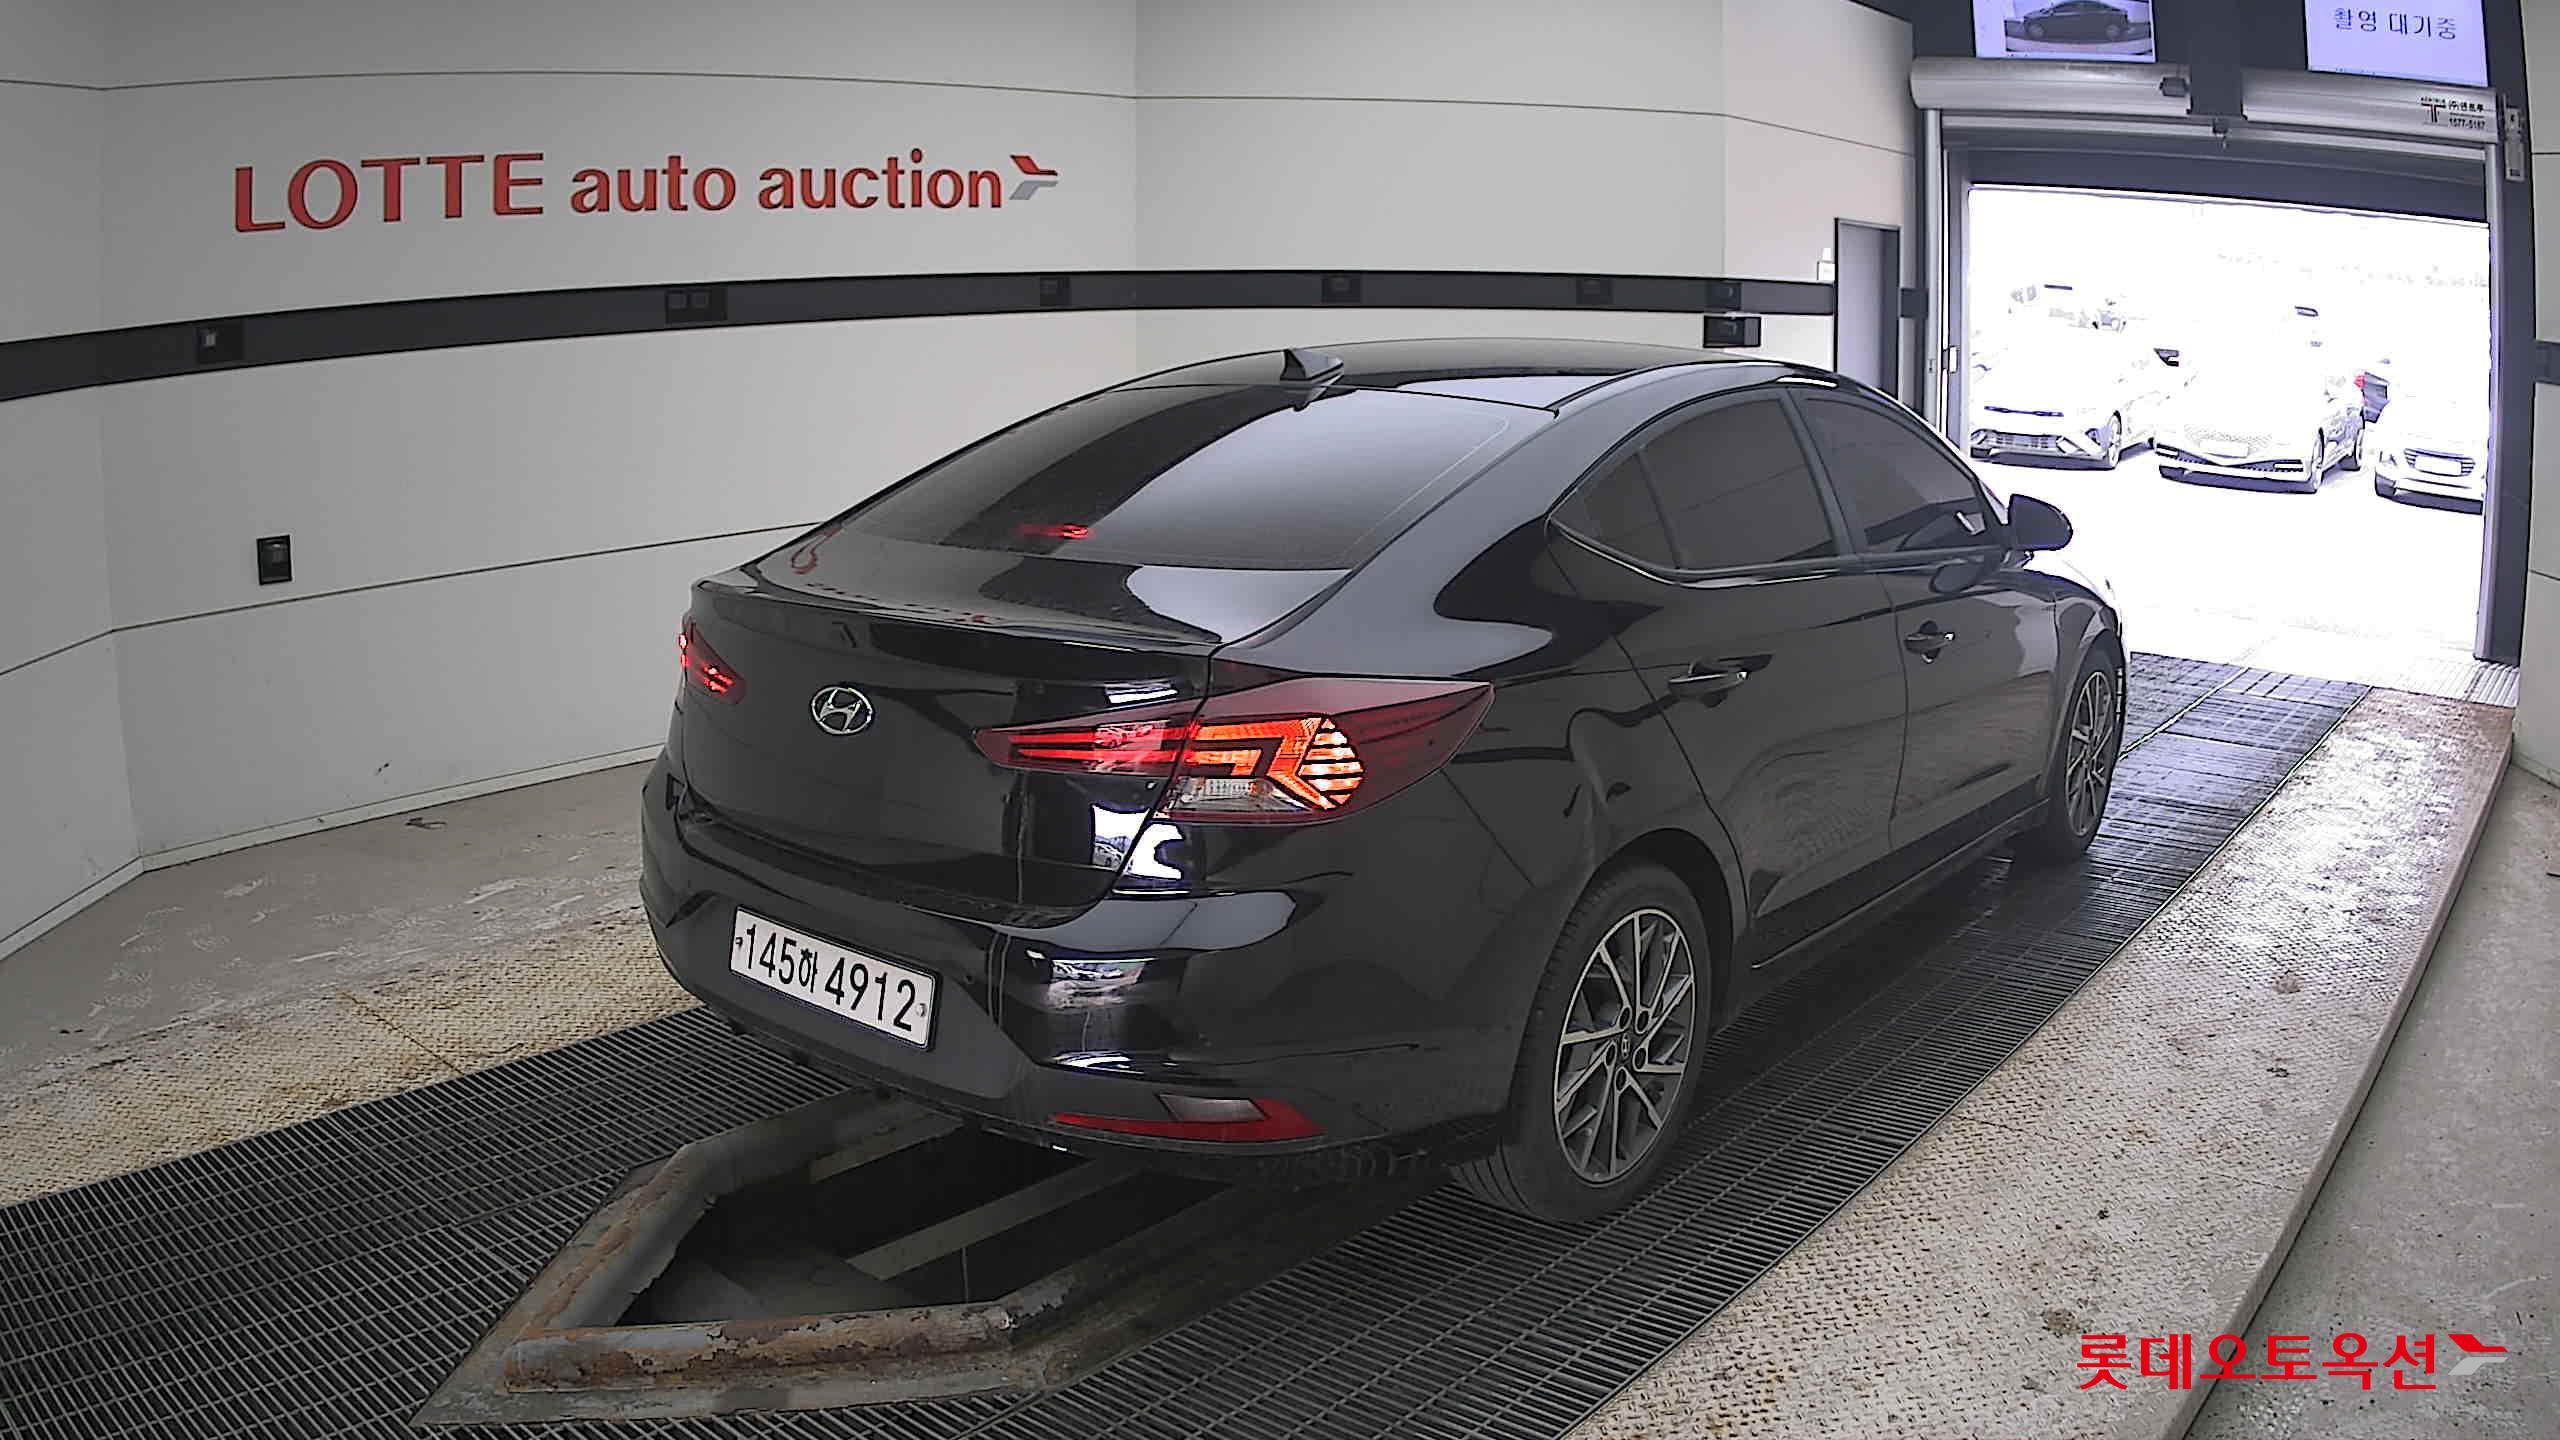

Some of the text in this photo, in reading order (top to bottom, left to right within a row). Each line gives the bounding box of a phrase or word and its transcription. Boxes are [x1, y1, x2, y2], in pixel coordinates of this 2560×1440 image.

[2334, 7, 2457, 40] 촬영 대기중
[235, 149, 1003, 232] LOTTE auto auction
[746, 923, 917, 1031] 145하 4912
